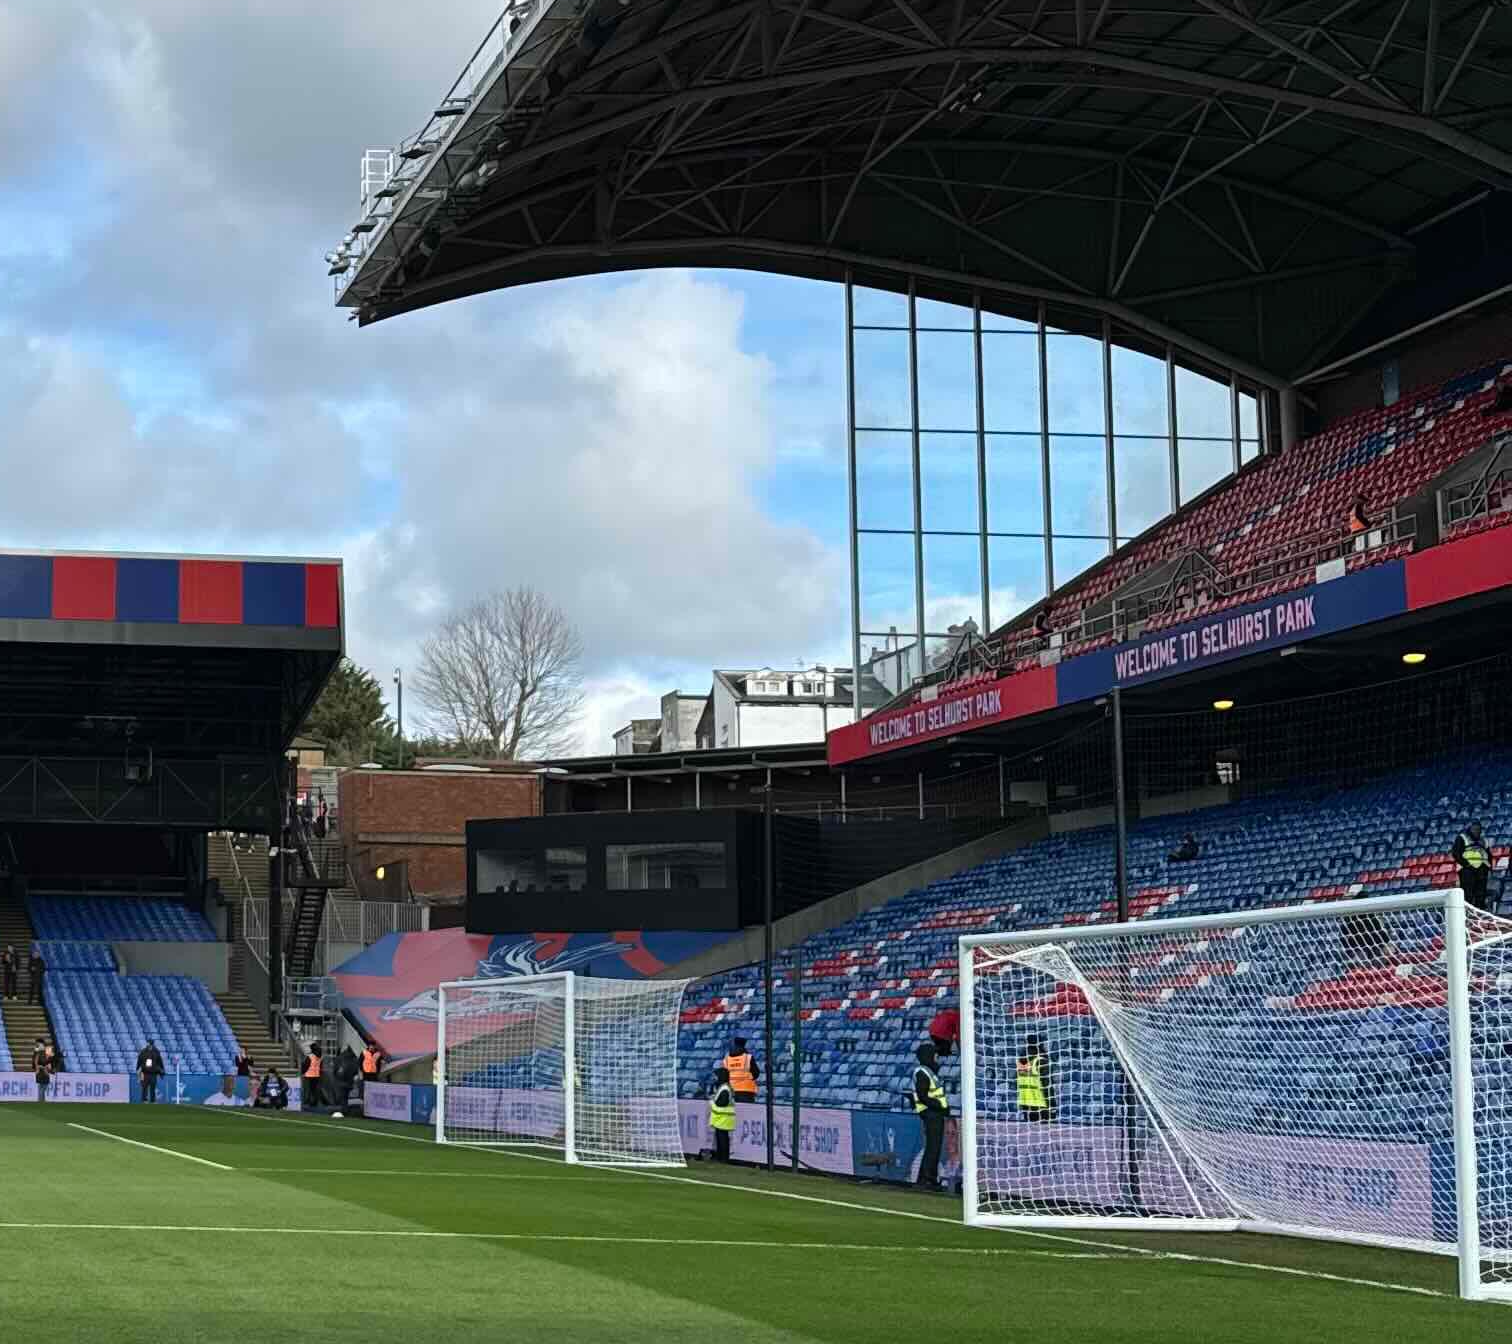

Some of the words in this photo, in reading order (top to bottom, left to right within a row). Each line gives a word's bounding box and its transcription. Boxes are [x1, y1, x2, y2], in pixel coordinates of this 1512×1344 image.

[1114, 636, 1178, 681] WELCOME
[1180, 631, 1198, 662] TO
[1201, 609, 1273, 656] SELHURST
[1276, 595, 1316, 635] PARK
[869, 714, 913, 746] WELCOME
[913, 712, 926, 735] TO
[927, 697, 974, 730] SELHURST
[975, 688, 1002, 718] PARK
[75, 1082, 111, 1098] SHOP
[814, 1125, 841, 1154] SHOP
